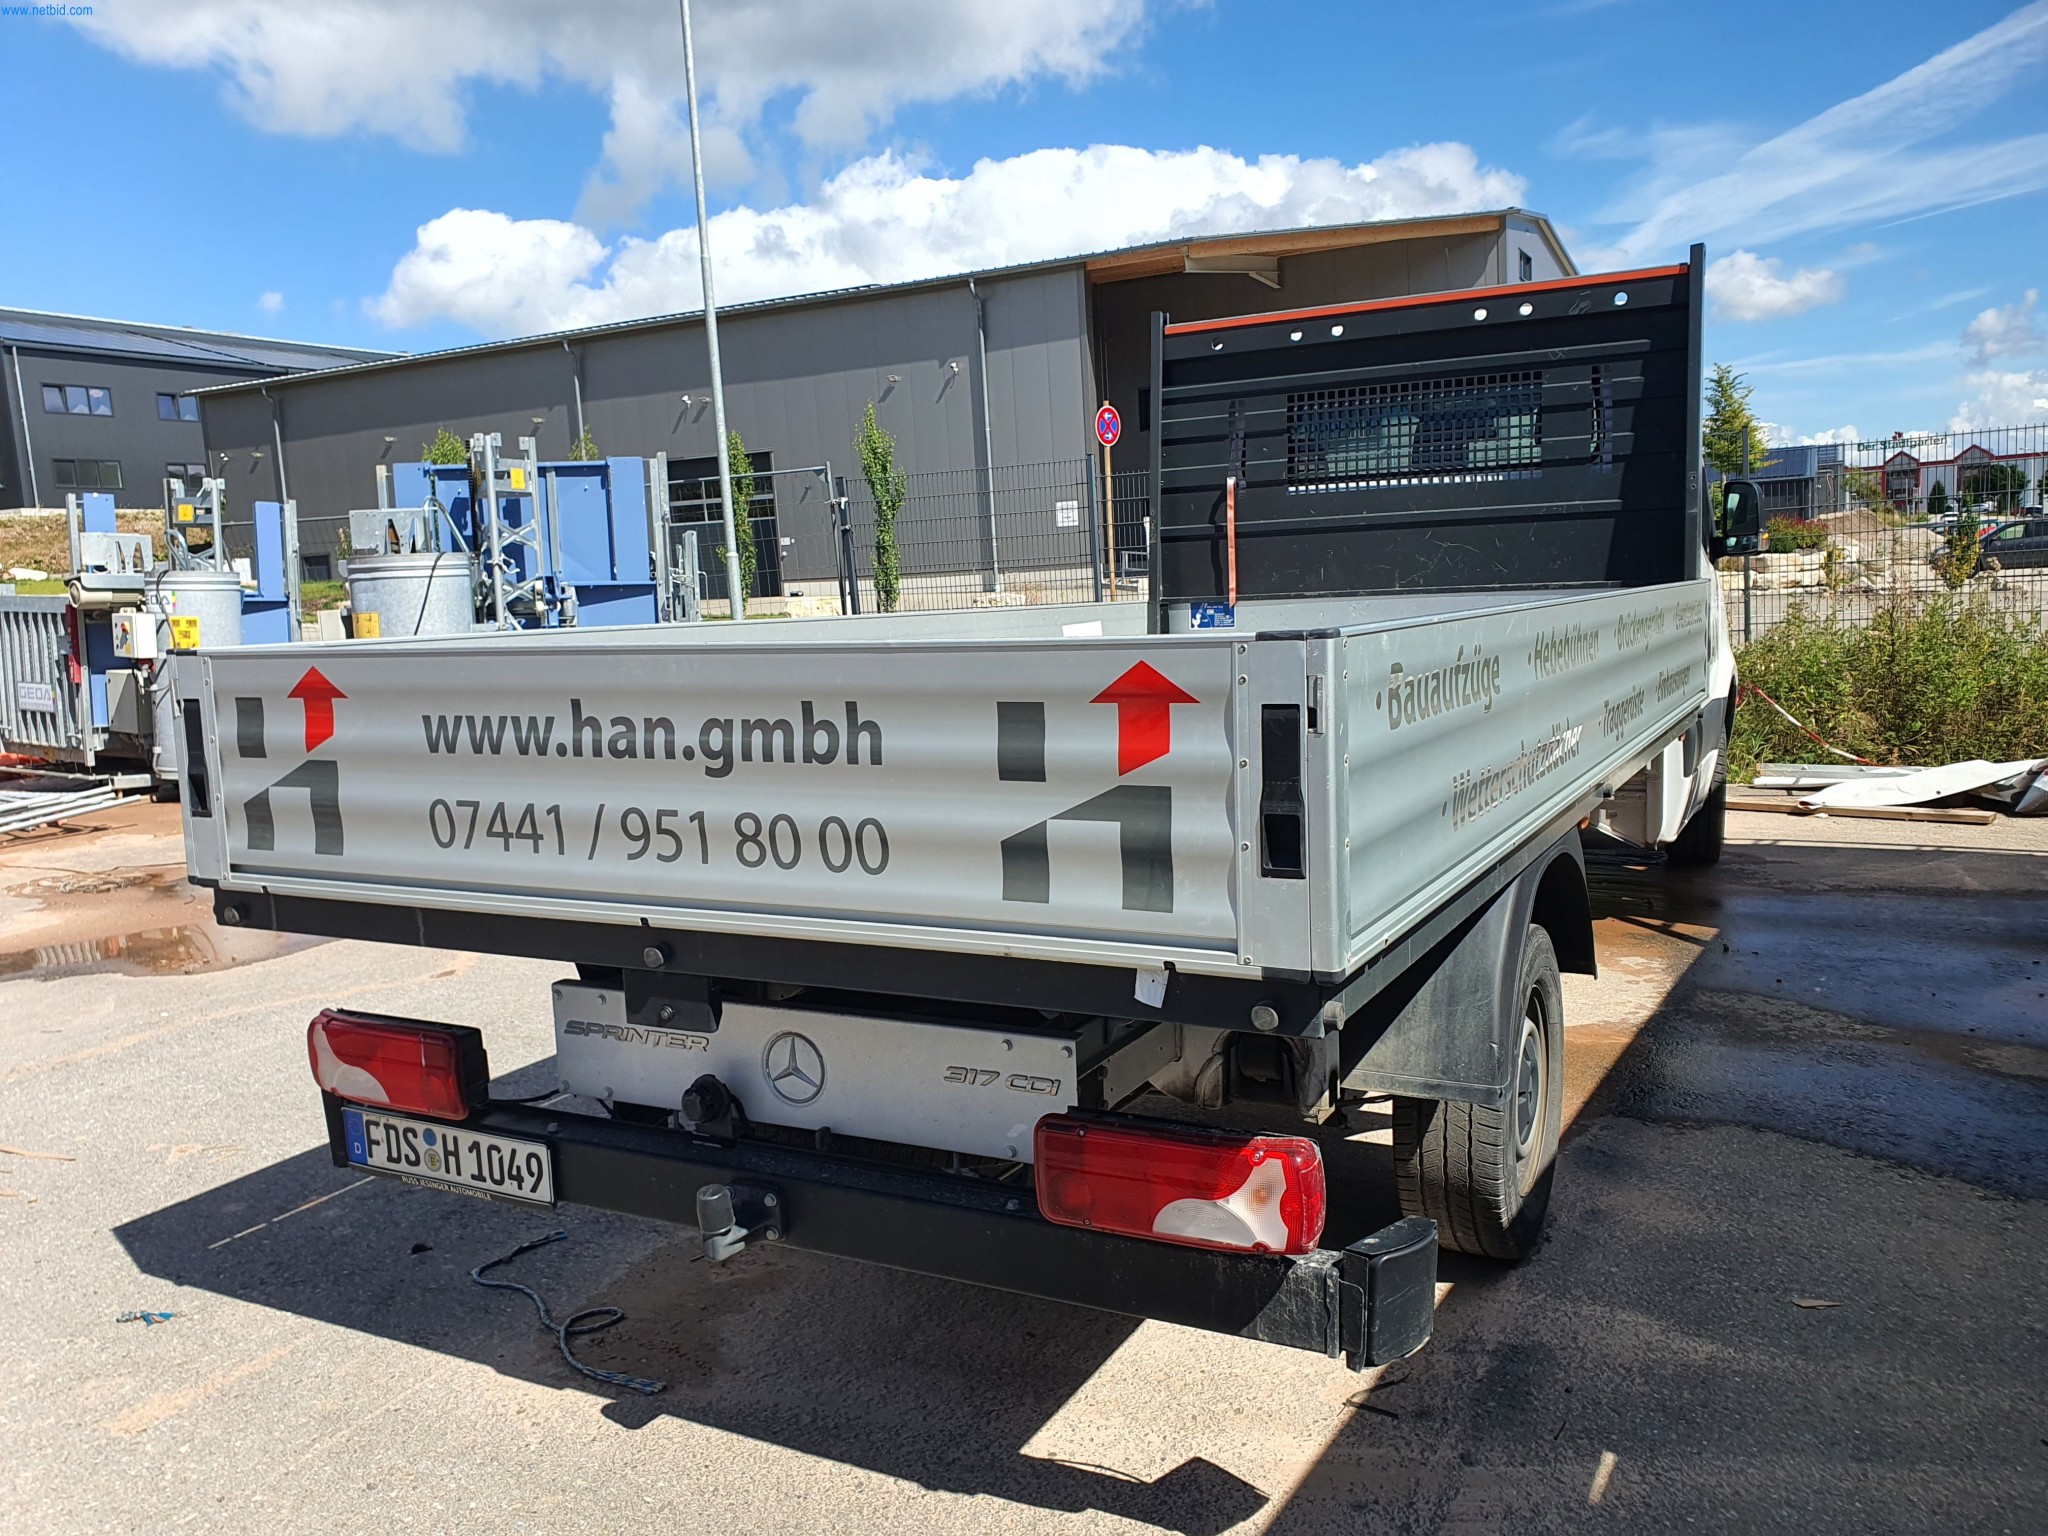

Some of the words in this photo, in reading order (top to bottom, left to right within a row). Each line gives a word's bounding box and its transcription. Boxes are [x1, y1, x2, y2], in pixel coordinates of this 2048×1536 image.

[1857, 442, 1877, 452] Der
[1880, 436, 1948, 450] Stadtgarten
[19, 686, 51, 701] GEDA
[422, 698, 884, 778] www.han.gmbh
[428, 798, 566, 856] 07441
[620, 806, 709, 864] 951
[734, 811, 801, 870] 80
[818, 815, 890, 876] 00
[563, 1019, 710, 1052] SPRINTER
[943, 1065, 1000, 1087] 317
[1005, 1073, 1061, 1097] CDI
[354, 1142, 362, 1155] D
[365, 1119, 421, 1167] FDS
[441, 1133, 462, 1177] H
[468, 1140, 544, 1194] 1049
[401, 1175, 419, 1186] RUSS
[419, 1179, 450, 1192] JESINGER
[450, 1186, 493, 1201] AUTOMOBILE
